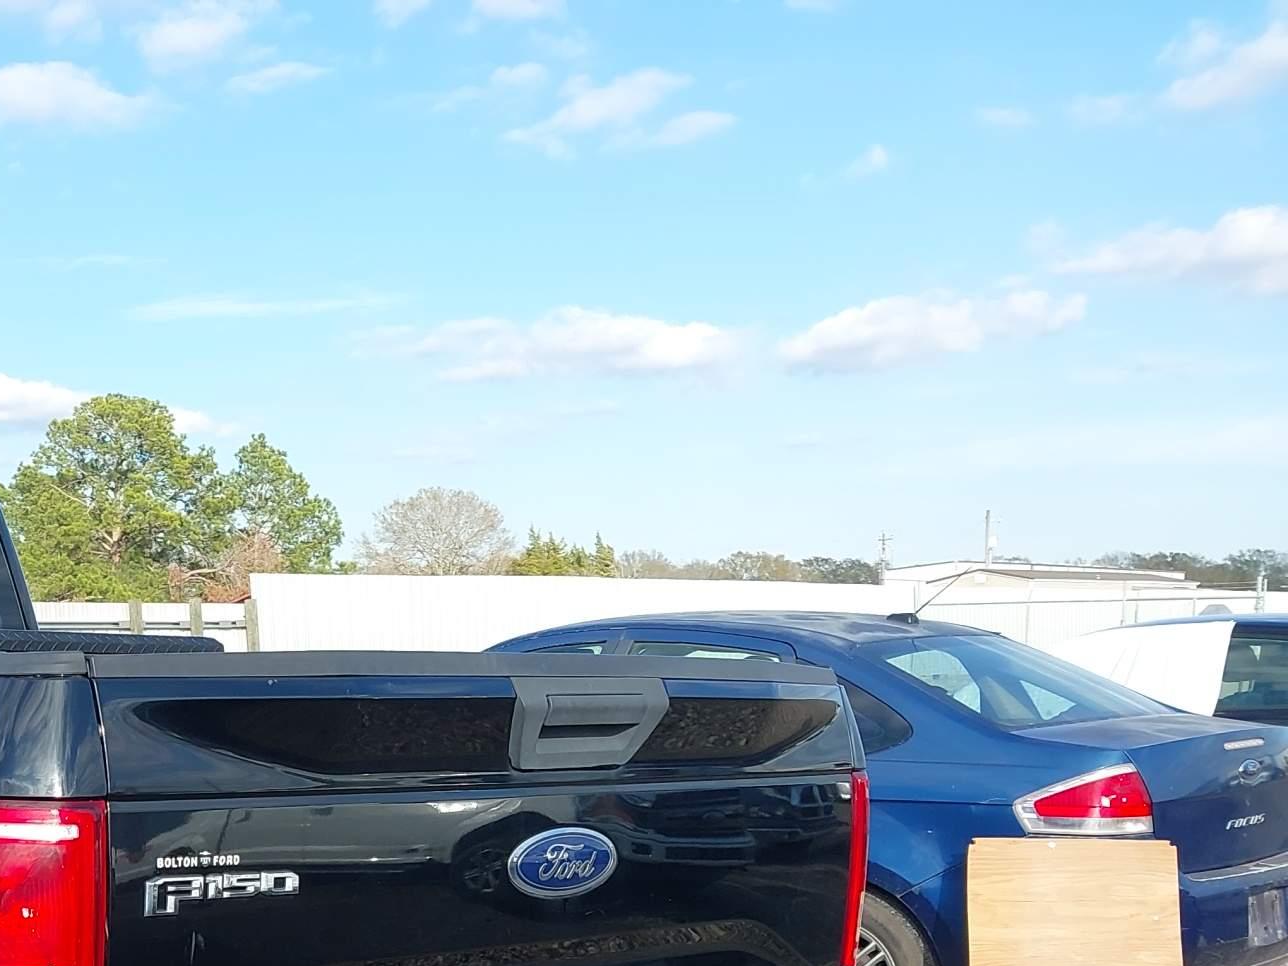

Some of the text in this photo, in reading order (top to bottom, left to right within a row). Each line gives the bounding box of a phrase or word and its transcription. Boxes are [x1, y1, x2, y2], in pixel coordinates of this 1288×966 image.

[1225, 812, 1266, 830] FOCUS
[156, 854, 240, 869] BOLTON FORD
[537, 843, 597, 881] Ford
